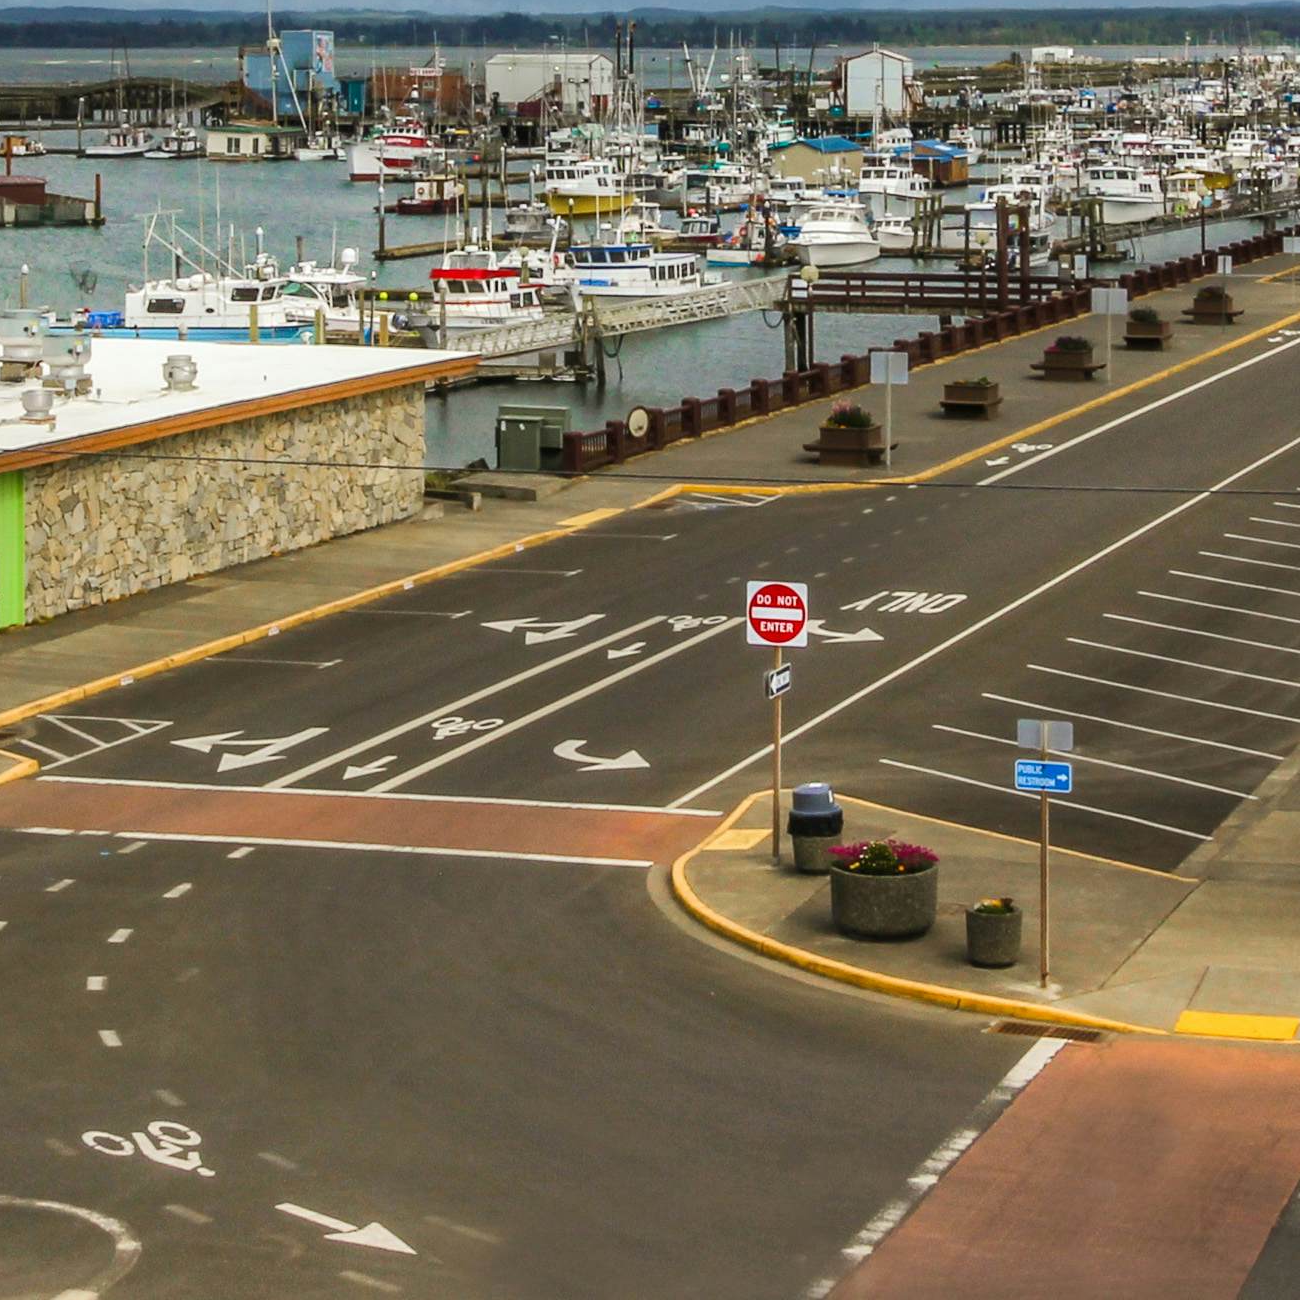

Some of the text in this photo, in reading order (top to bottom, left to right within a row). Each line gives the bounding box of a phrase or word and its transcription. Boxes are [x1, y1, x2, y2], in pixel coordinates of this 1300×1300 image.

[757, 594, 798, 606] DO NOT
[840, 591, 968, 614] ONLY
[760, 621, 794, 633] ENTER
[1018, 764, 1043, 775] PUBLIC
[1018, 776, 1056, 787] RESTROOM
